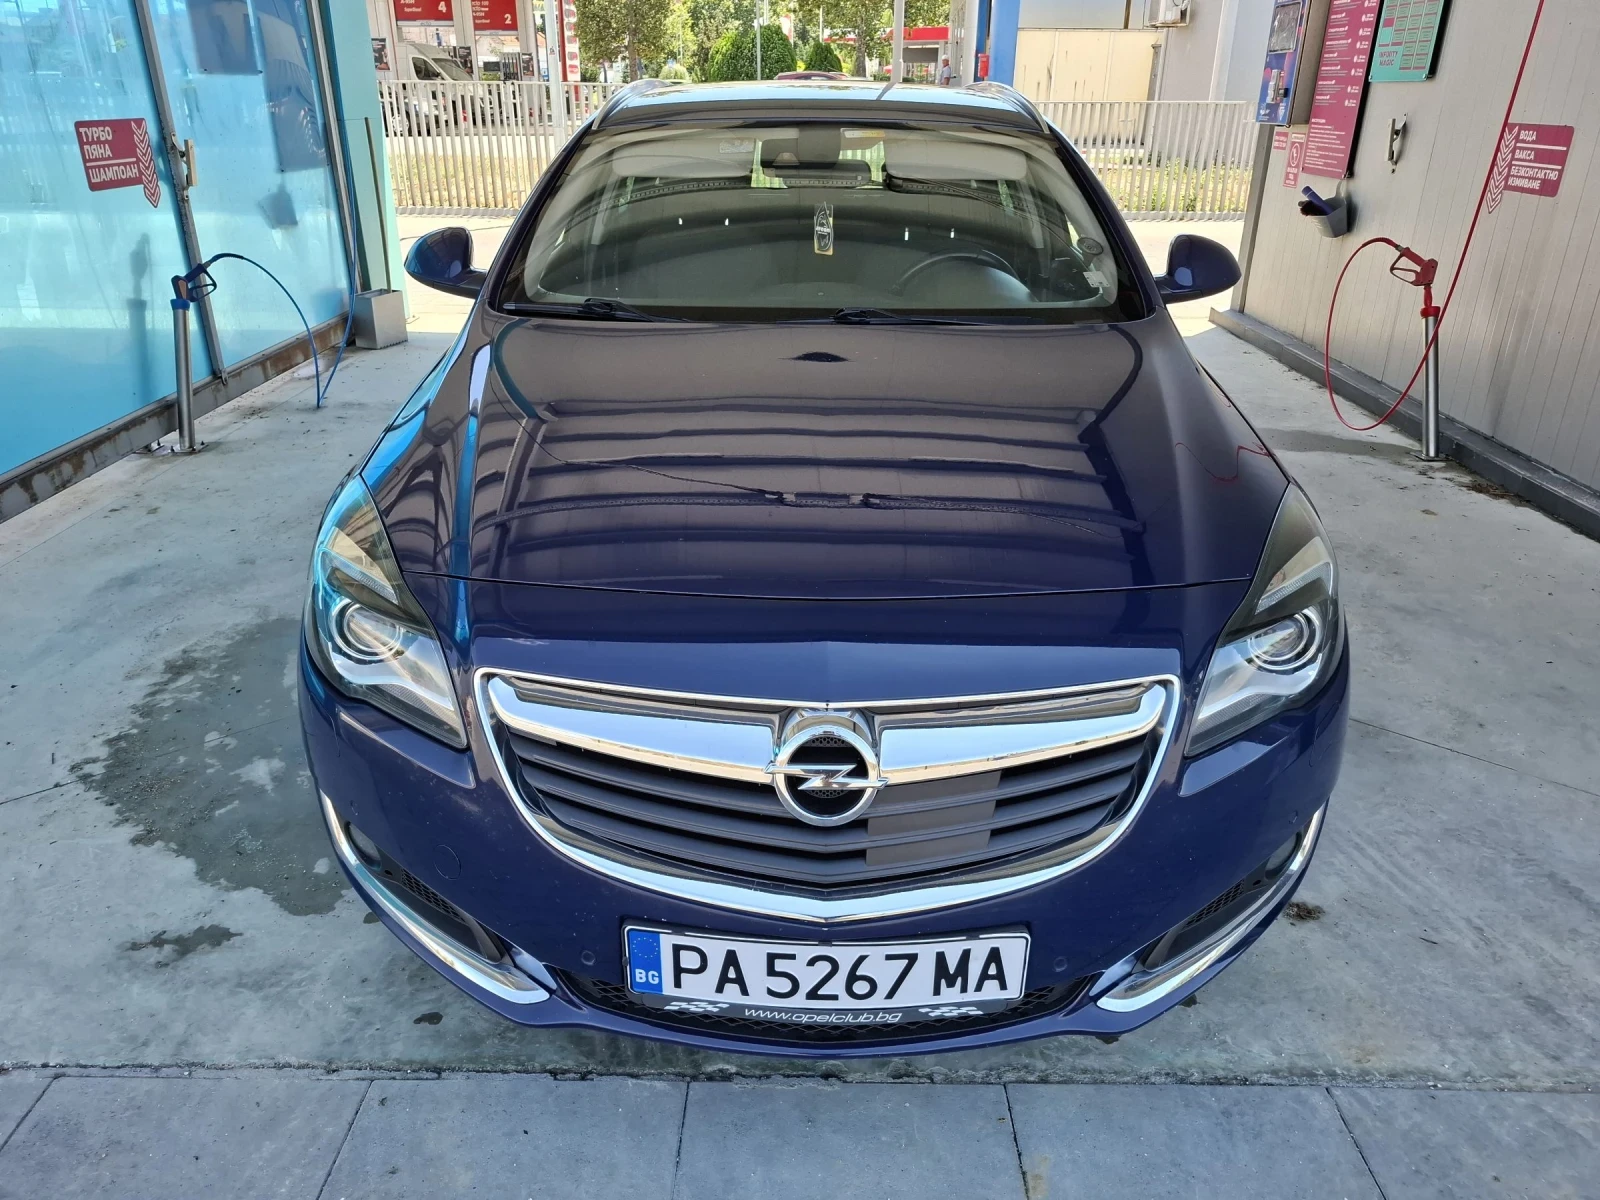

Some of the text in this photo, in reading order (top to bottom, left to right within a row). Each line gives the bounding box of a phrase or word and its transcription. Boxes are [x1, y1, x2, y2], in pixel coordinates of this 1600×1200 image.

[438, 1, 447, 13] 4
[504, 13, 512, 24] 2
[79, 126, 113, 142] ТУРБО
[1519, 130, 1537, 142] ВОДА
[83, 143, 112, 160] ПЯНА
[1514, 149, 1535, 160] ВАКСА
[88, 163, 139, 183] ШАМПОАН
[1510, 166, 1559, 181] БЕЗКОНТАКТНО
[1507, 176, 1541, 190] ИЗМИВАНЕ
[635, 968, 660, 985] BG
[671, 943, 1009, 1001] PA 5267 MA
[744, 1008, 903, 1024] www.opelclub.bg
